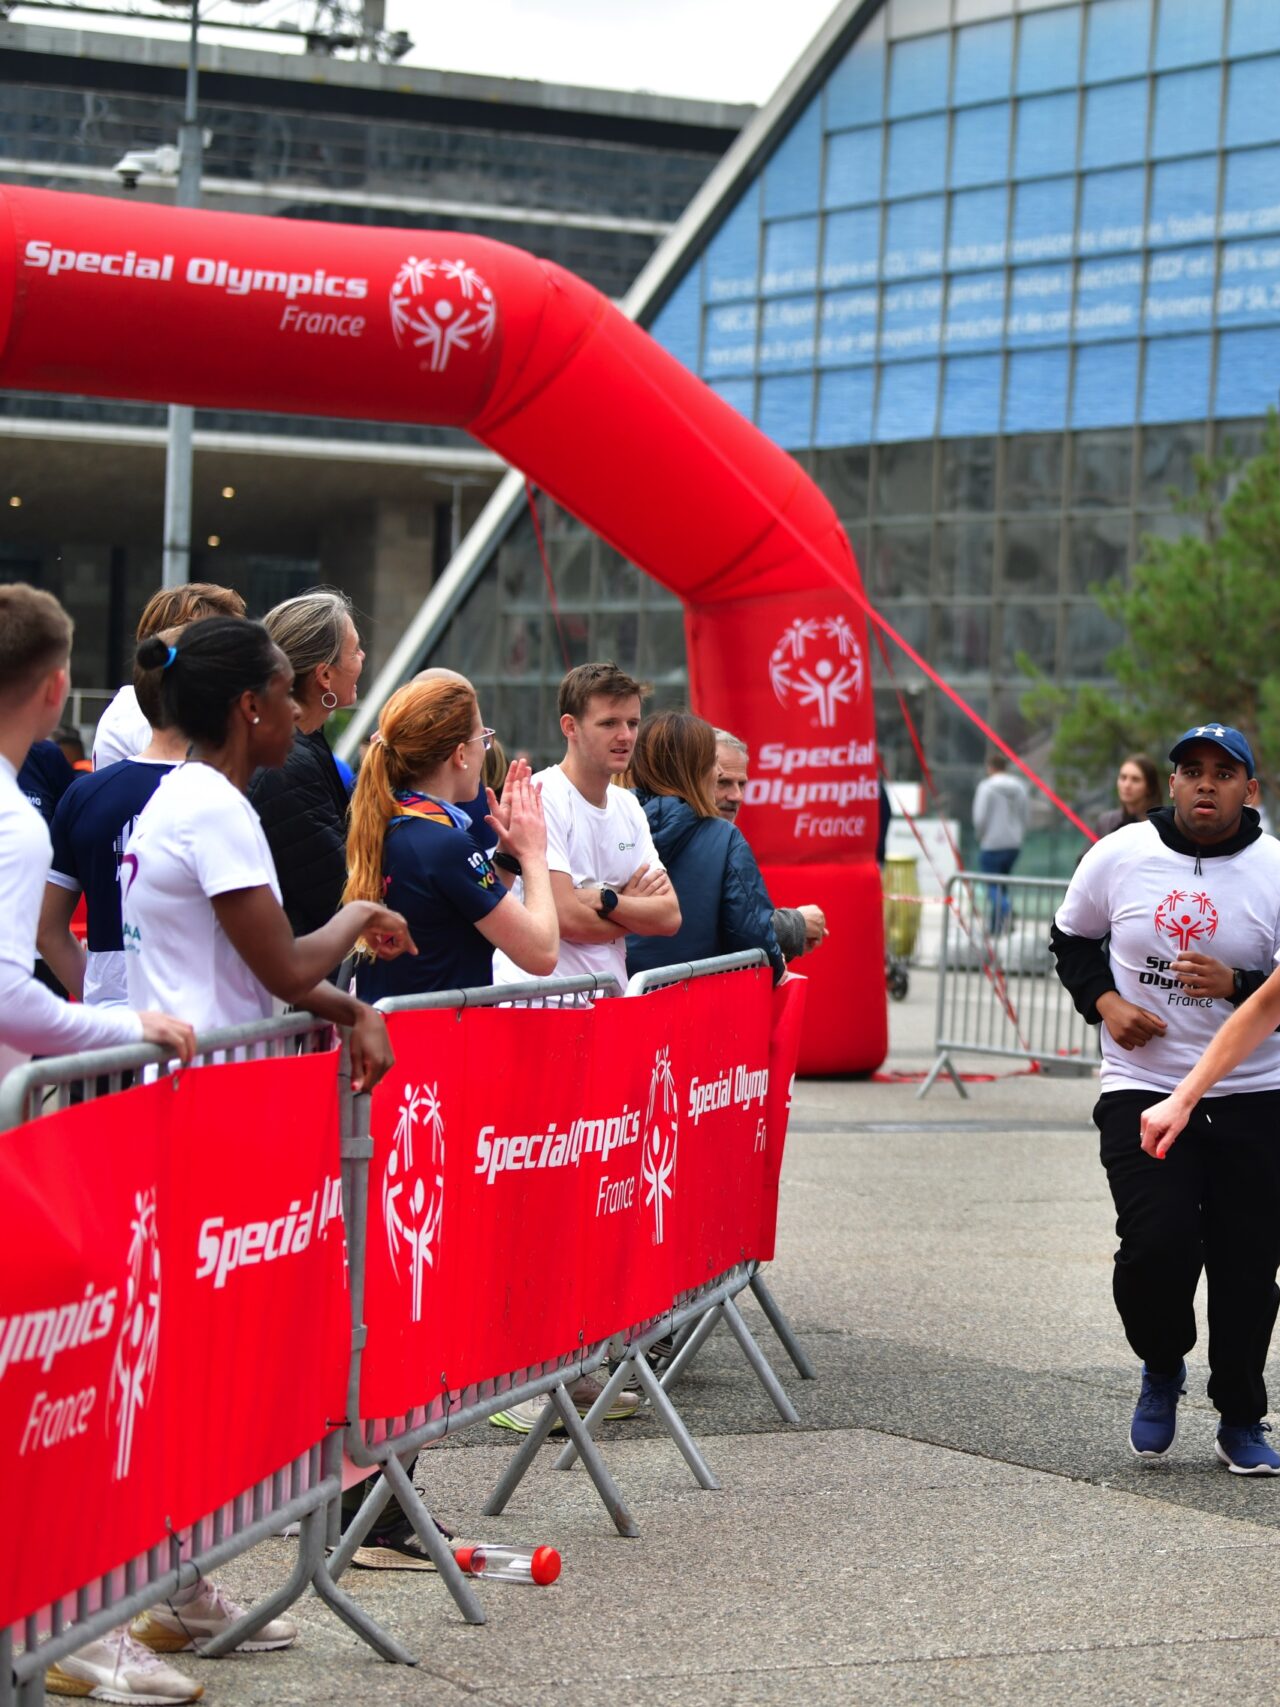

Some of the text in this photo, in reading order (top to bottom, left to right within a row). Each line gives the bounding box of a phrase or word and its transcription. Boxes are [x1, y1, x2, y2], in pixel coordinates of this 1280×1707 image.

[24, 240, 368, 299] Special Olympics
[279, 305, 366, 337] France
[758, 739, 874, 775] Special
[794, 814, 866, 838] France
[1168, 993, 1213, 1008] France
[688, 1067, 733, 1126] Special
[734, 1063, 769, 1111] Olymp
[475, 1121, 576, 1185] Special
[595, 1175, 635, 1208] France
[196, 1190, 318, 1290] Special
[0, 1281, 118, 1383] ympics
[19, 1386, 96, 1457] France
